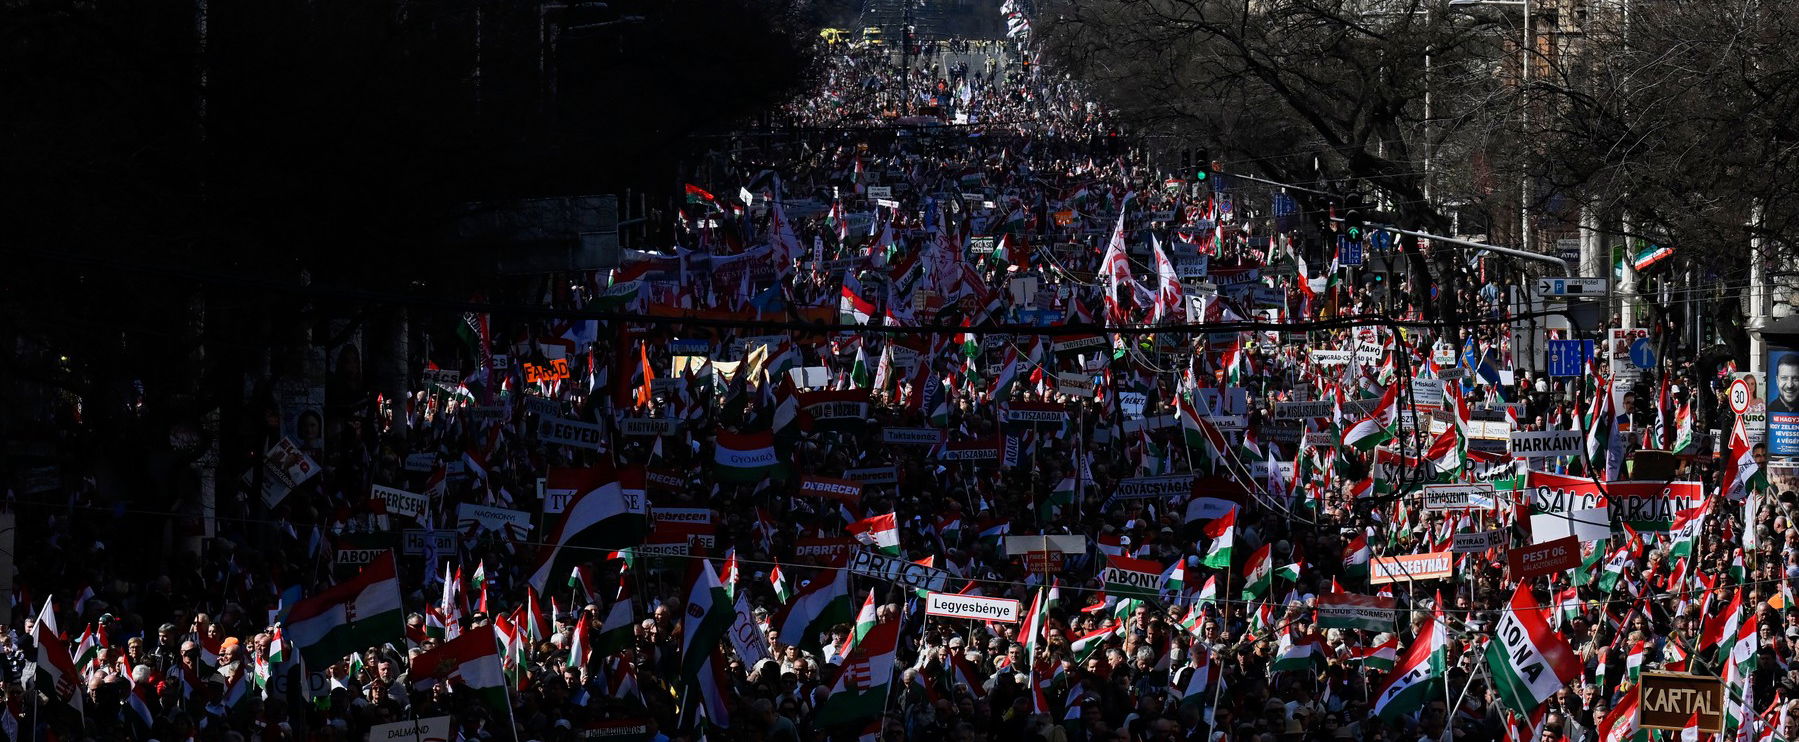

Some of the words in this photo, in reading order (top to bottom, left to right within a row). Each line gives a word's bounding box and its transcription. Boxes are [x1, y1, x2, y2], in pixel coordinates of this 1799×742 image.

[1359, 344, 1382, 356] MAKÓ
[1734, 390, 1745, 404] 30
[1744, 413, 1765, 422] URÓ
[554, 423, 601, 444] EGYED
[1512, 435, 1582, 453] HARKÁNY
[802, 482, 861, 496] DEBRECEN
[408, 534, 452, 549] Haan
[341, 550, 380, 563] ABON
[796, 543, 862, 556] DEBRECN
[1522, 552, 1550, 564] PEST
[1551, 548, 1568, 559] 06.
[1107, 569, 1161, 590] ABONY
[933, 598, 1010, 617] Legyesbénye
[1643, 687, 1720, 716] KARTAL
